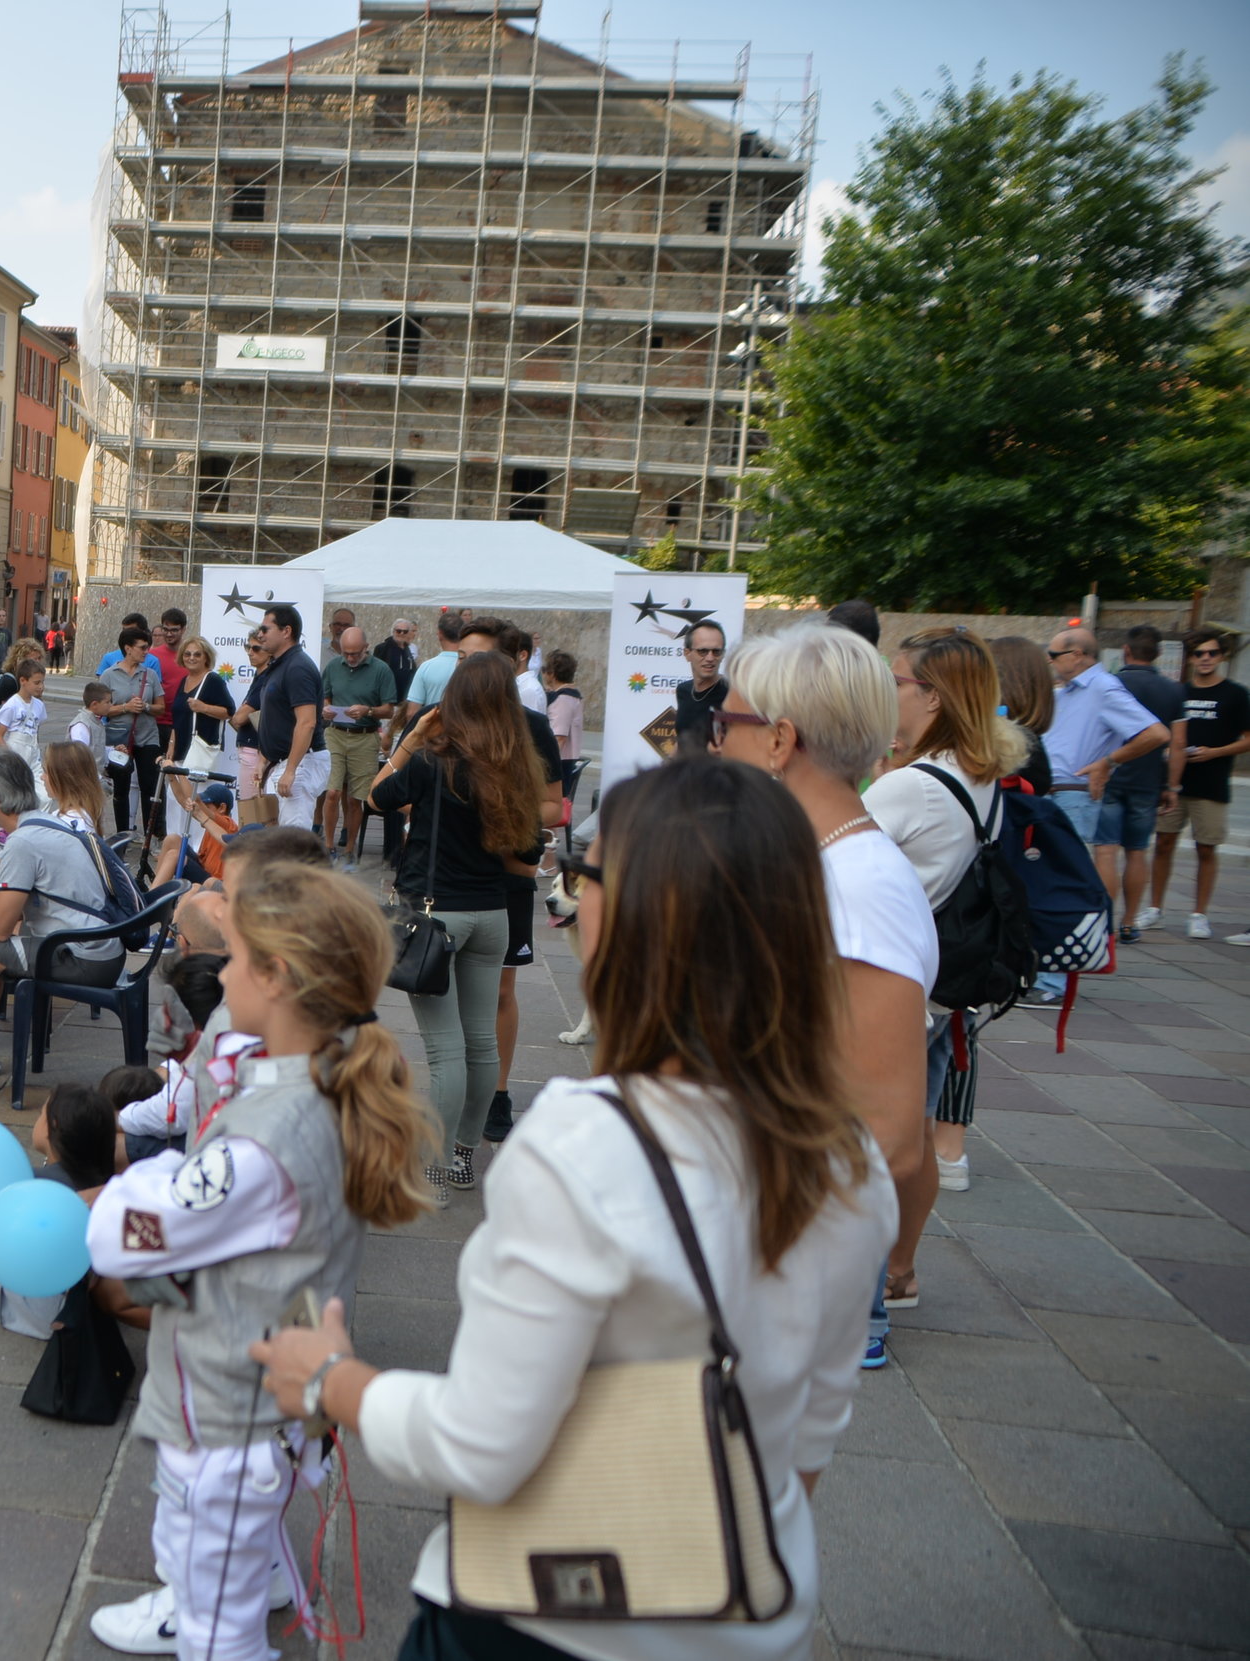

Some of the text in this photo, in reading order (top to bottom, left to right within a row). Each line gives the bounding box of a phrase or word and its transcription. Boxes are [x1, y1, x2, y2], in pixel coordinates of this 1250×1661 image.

[214, 636, 246, 647] COMEN
[625, 645, 674, 656] COMENSE
[651, 728, 678, 737] MILA
